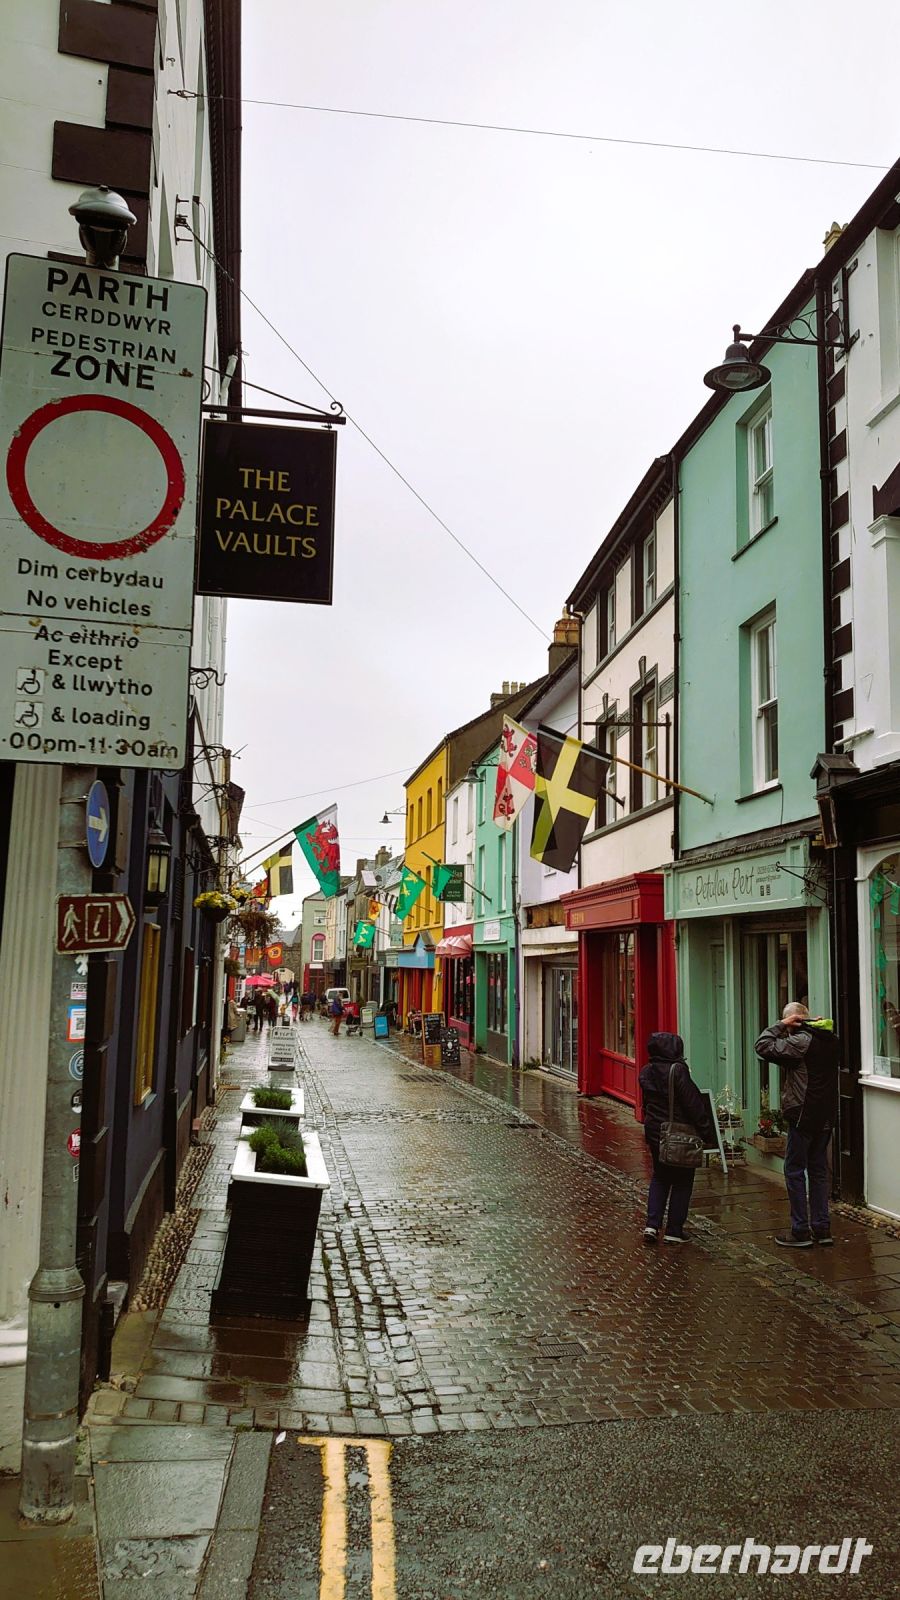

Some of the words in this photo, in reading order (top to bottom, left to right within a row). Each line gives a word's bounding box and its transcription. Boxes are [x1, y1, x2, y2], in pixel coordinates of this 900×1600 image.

[47, 267, 169, 312] PARTH
[42, 301, 171, 336] CERDDWYR
[31, 326, 177, 364] PEDESTRIAN
[50, 350, 156, 391] ZONE
[238, 467, 291, 492] THE
[215, 497, 320, 526] PALACE
[215, 529, 317, 559] VAULTS
[17, 557, 59, 579] Dim
[65, 566, 164, 589] cerbydau
[26, 589, 58, 609] No
[63, 595, 151, 617] vehicles
[34, 624, 64, 642] Ac
[69, 628, 140, 649] eithrio
[48, 649, 123, 672] Except
[51, 673, 66, 690] &
[72, 674, 153, 697] llwytho
[51, 706, 65, 723] &
[72, 707, 151, 731] loading
